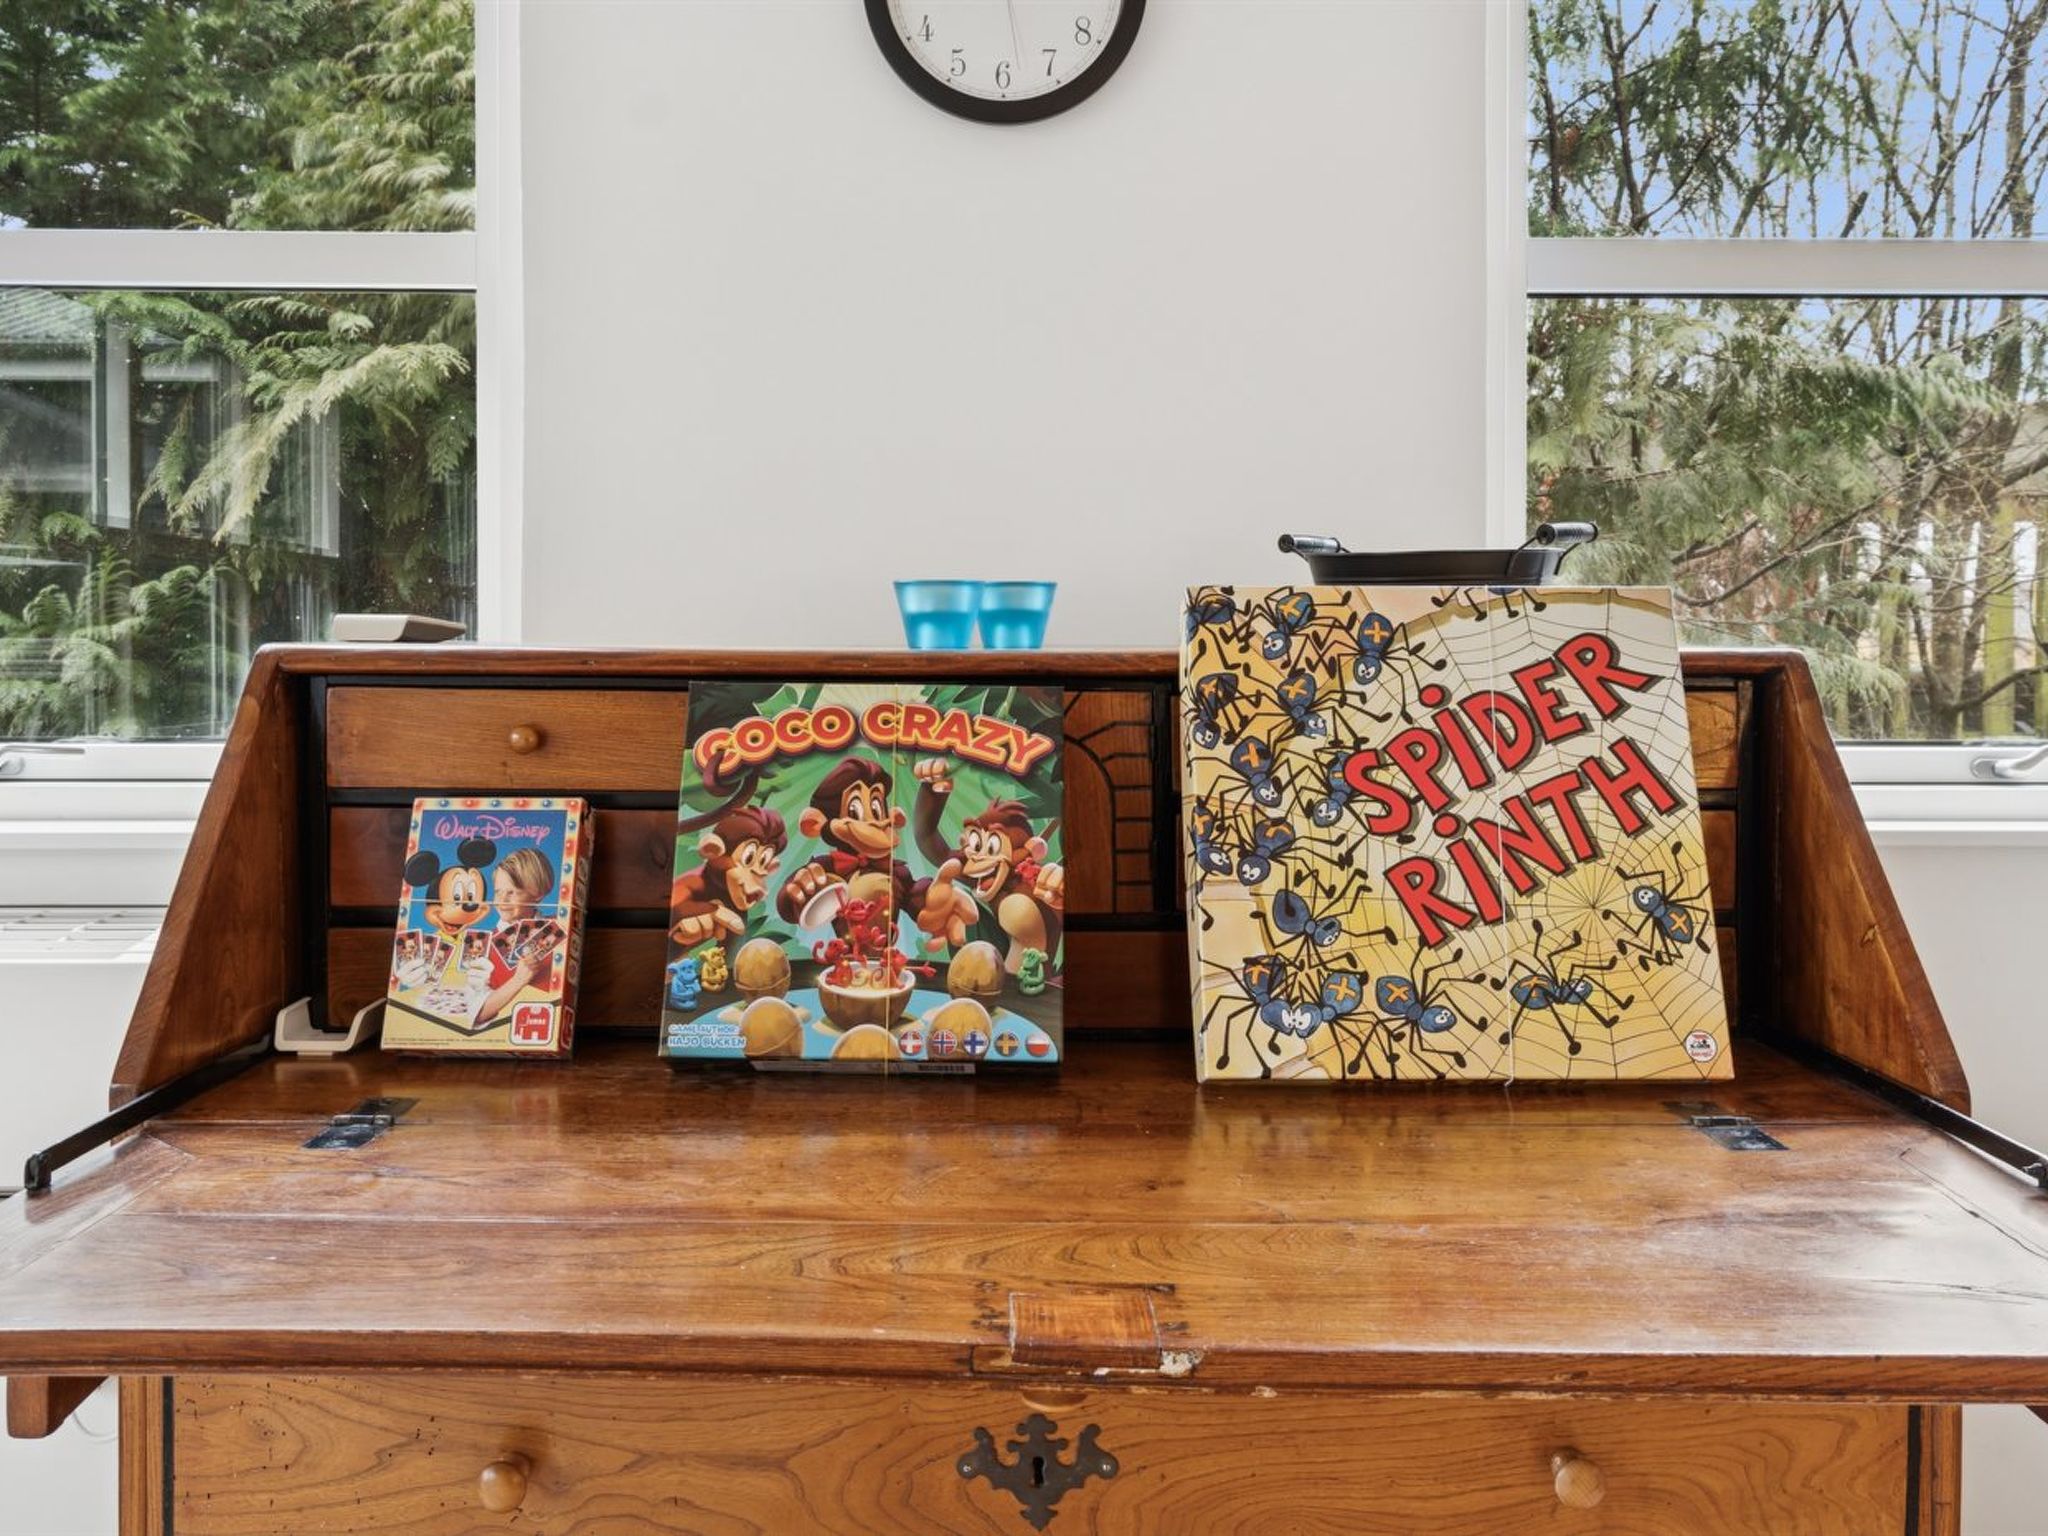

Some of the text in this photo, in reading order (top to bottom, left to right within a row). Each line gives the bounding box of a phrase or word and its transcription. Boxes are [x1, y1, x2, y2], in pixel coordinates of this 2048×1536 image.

[917, 15, 934, 42] 4
[1074, 16, 1092, 45] 8
[951, 49, 966, 77] 5
[995, 61, 1010, 89] 6
[1042, 49, 1057, 76] 7
[695, 706, 855, 774] COCO
[861, 702, 1054, 775] CRAZY
[668, 1036, 700, 1047] HAJO
